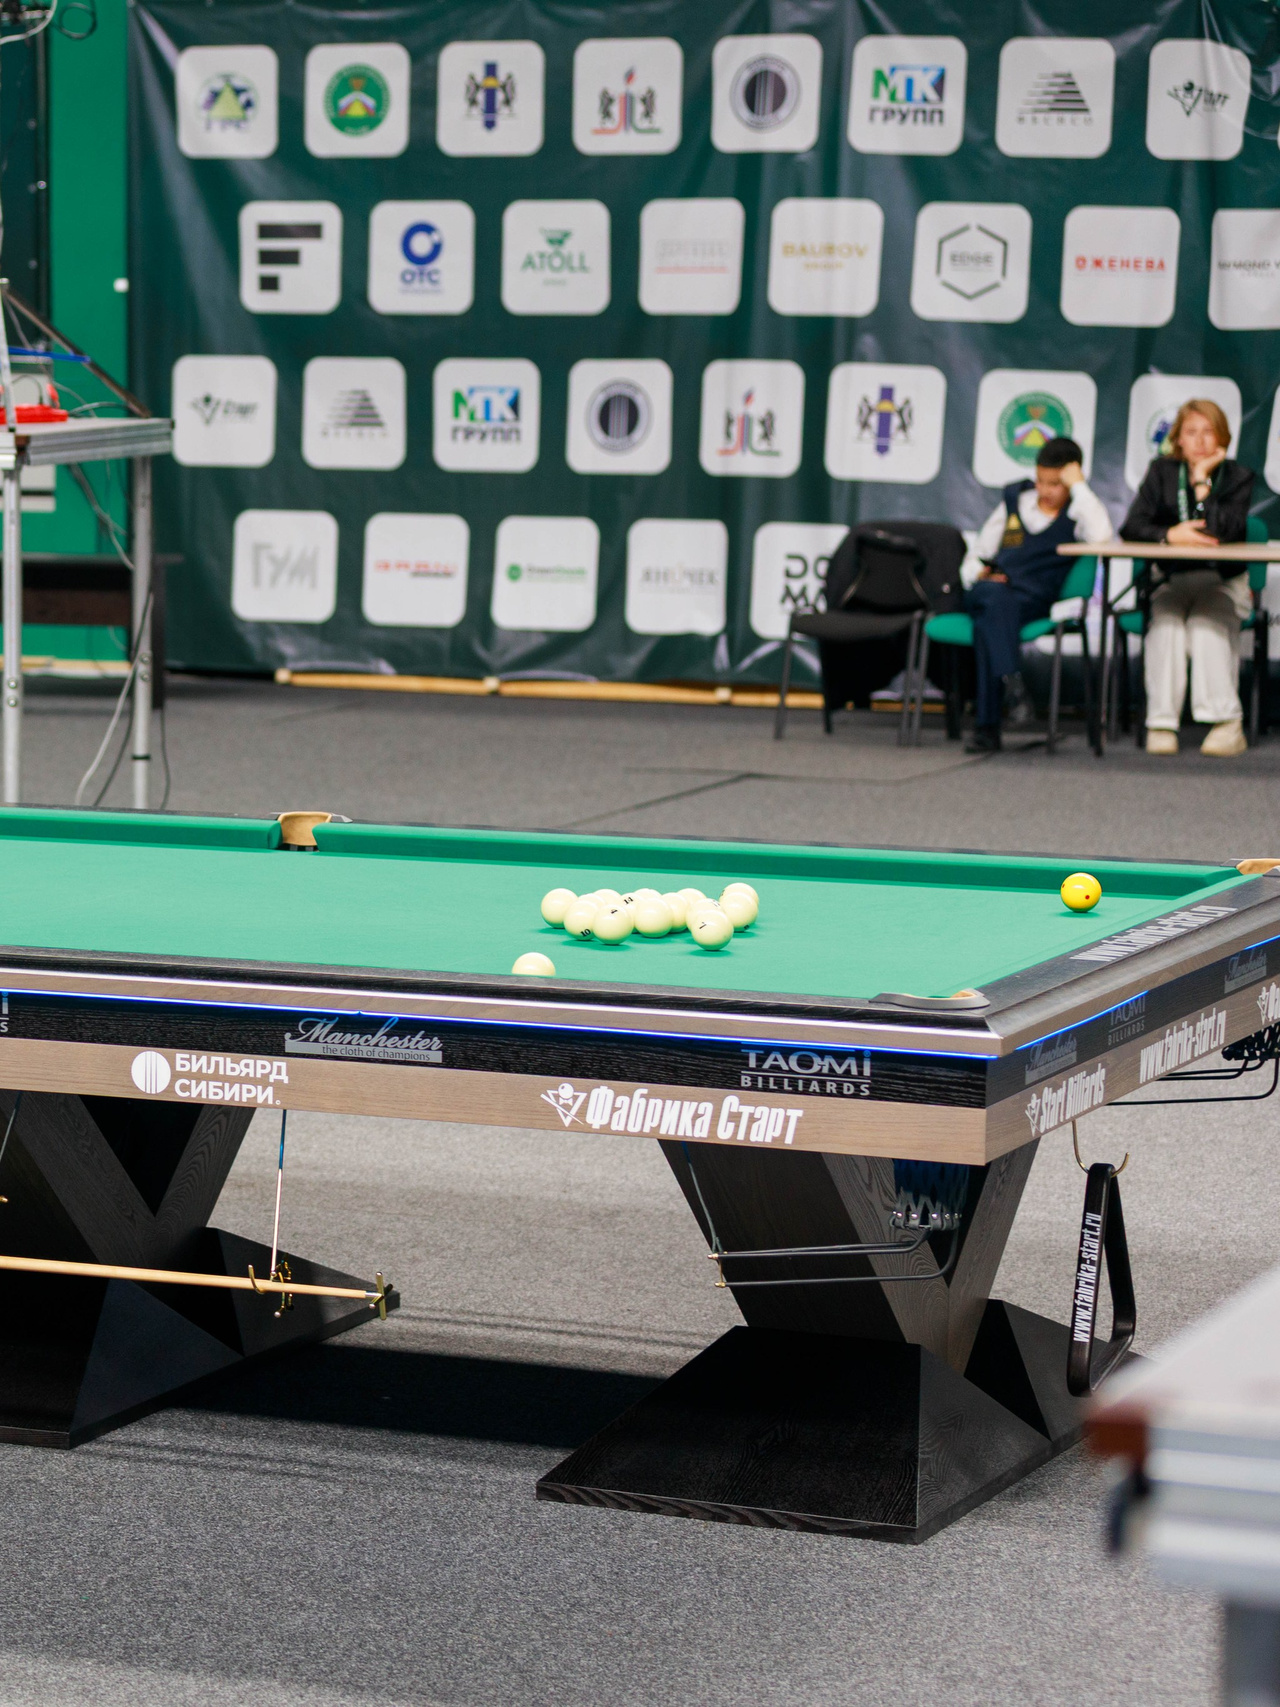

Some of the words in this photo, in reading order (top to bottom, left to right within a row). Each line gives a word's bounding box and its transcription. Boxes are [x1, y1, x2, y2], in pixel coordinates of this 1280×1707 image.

[869, 106, 944, 125] ГРУПП
[781, 242, 869, 259] BAUROV
[451, 425, 520, 443] ГРУПП
[284, 1016, 443, 1051] Manchester
[1139, 1007, 1227, 1084] www.fabrika-start.ru
[175, 1053, 289, 1083] БИЛЬЯРД
[322, 1045, 338, 1055] the
[340, 1045, 362, 1056] cloth
[364, 1047, 376, 1057] of
[378, 1049, 431, 1062] champions
[741, 1075, 871, 1096] BILLIARDS
[1040, 1081, 1067, 1133] Start
[1065, 1063, 1106, 1119] Billiards
[585, 1085, 714, 1138] Фабрика
[716, 1095, 804, 1144] Старт
[1073, 1212, 1102, 1343] www.fabrika-start.ru
